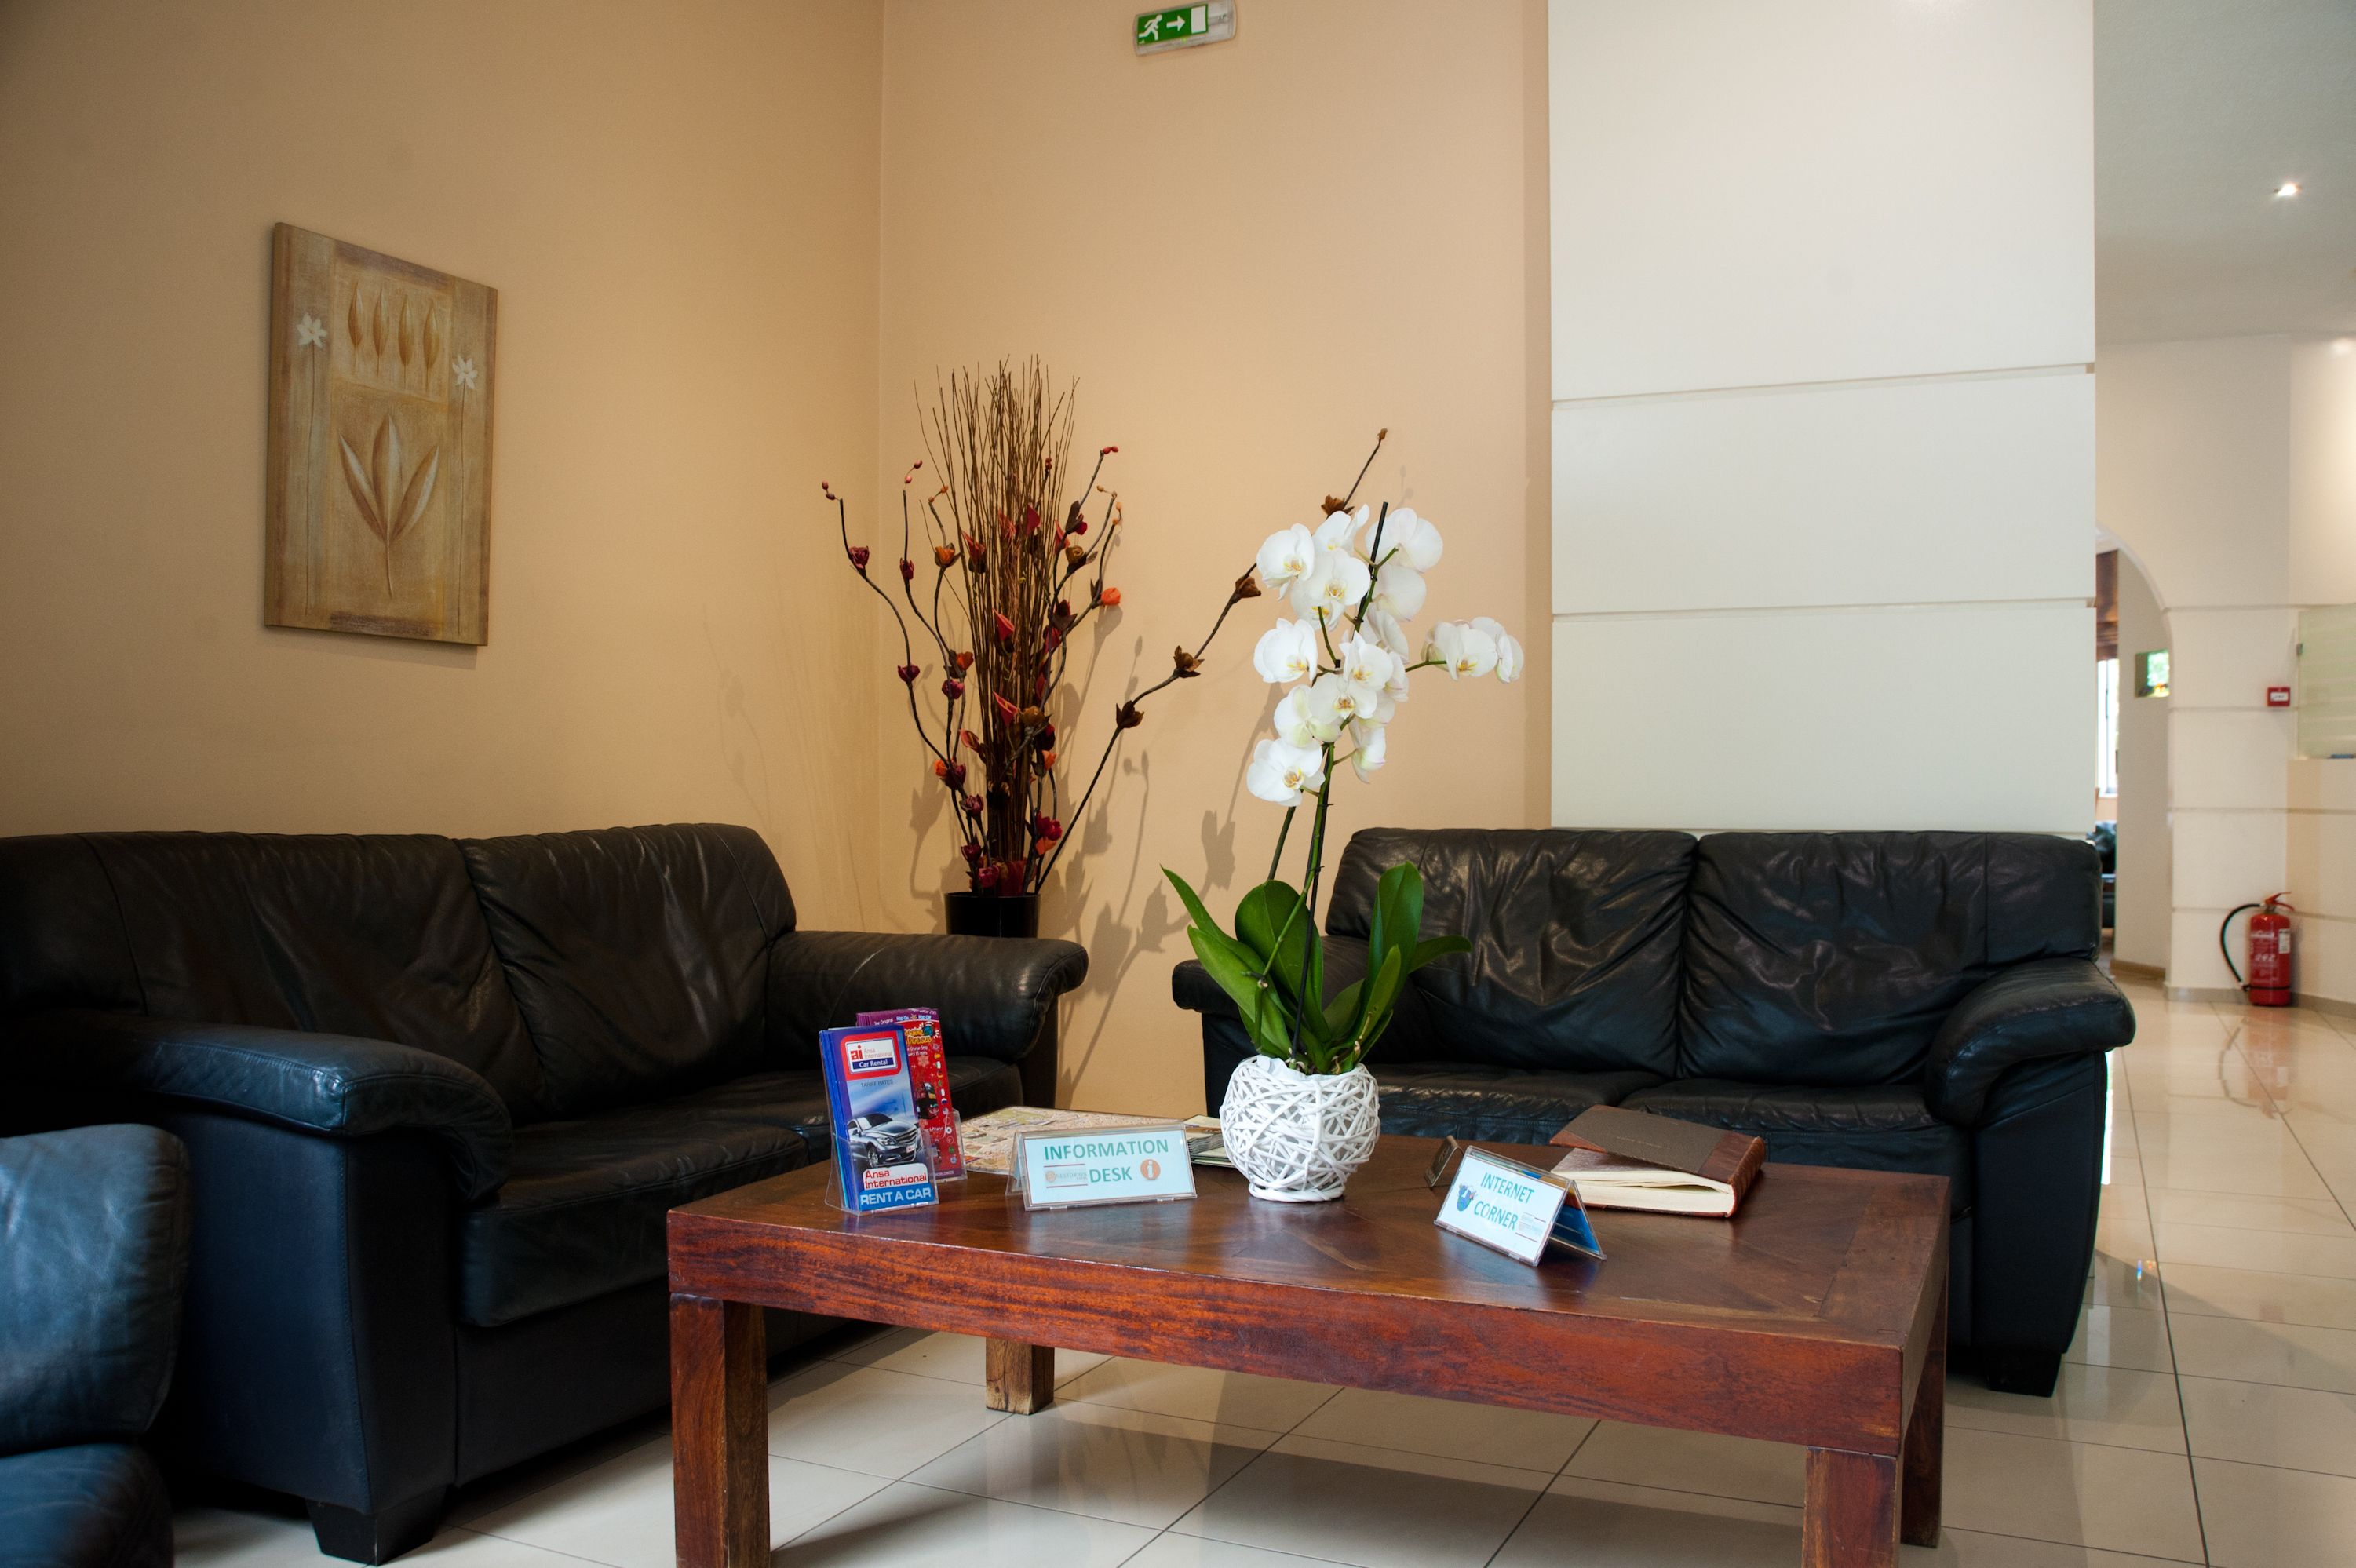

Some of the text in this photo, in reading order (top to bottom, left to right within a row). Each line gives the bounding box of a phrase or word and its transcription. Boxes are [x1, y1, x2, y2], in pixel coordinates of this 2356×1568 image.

[1044, 1139, 1169, 1161] INFORMATION
[865, 1170, 890, 1180] Ansa
[865, 1172, 927, 1189] International
[1089, 1166, 1132, 1183] DESK
[860, 1187, 932, 1206] RENT A CAR
[1480, 1172, 1535, 1204] INTERNET
[1473, 1200, 1519, 1231] CORNER
